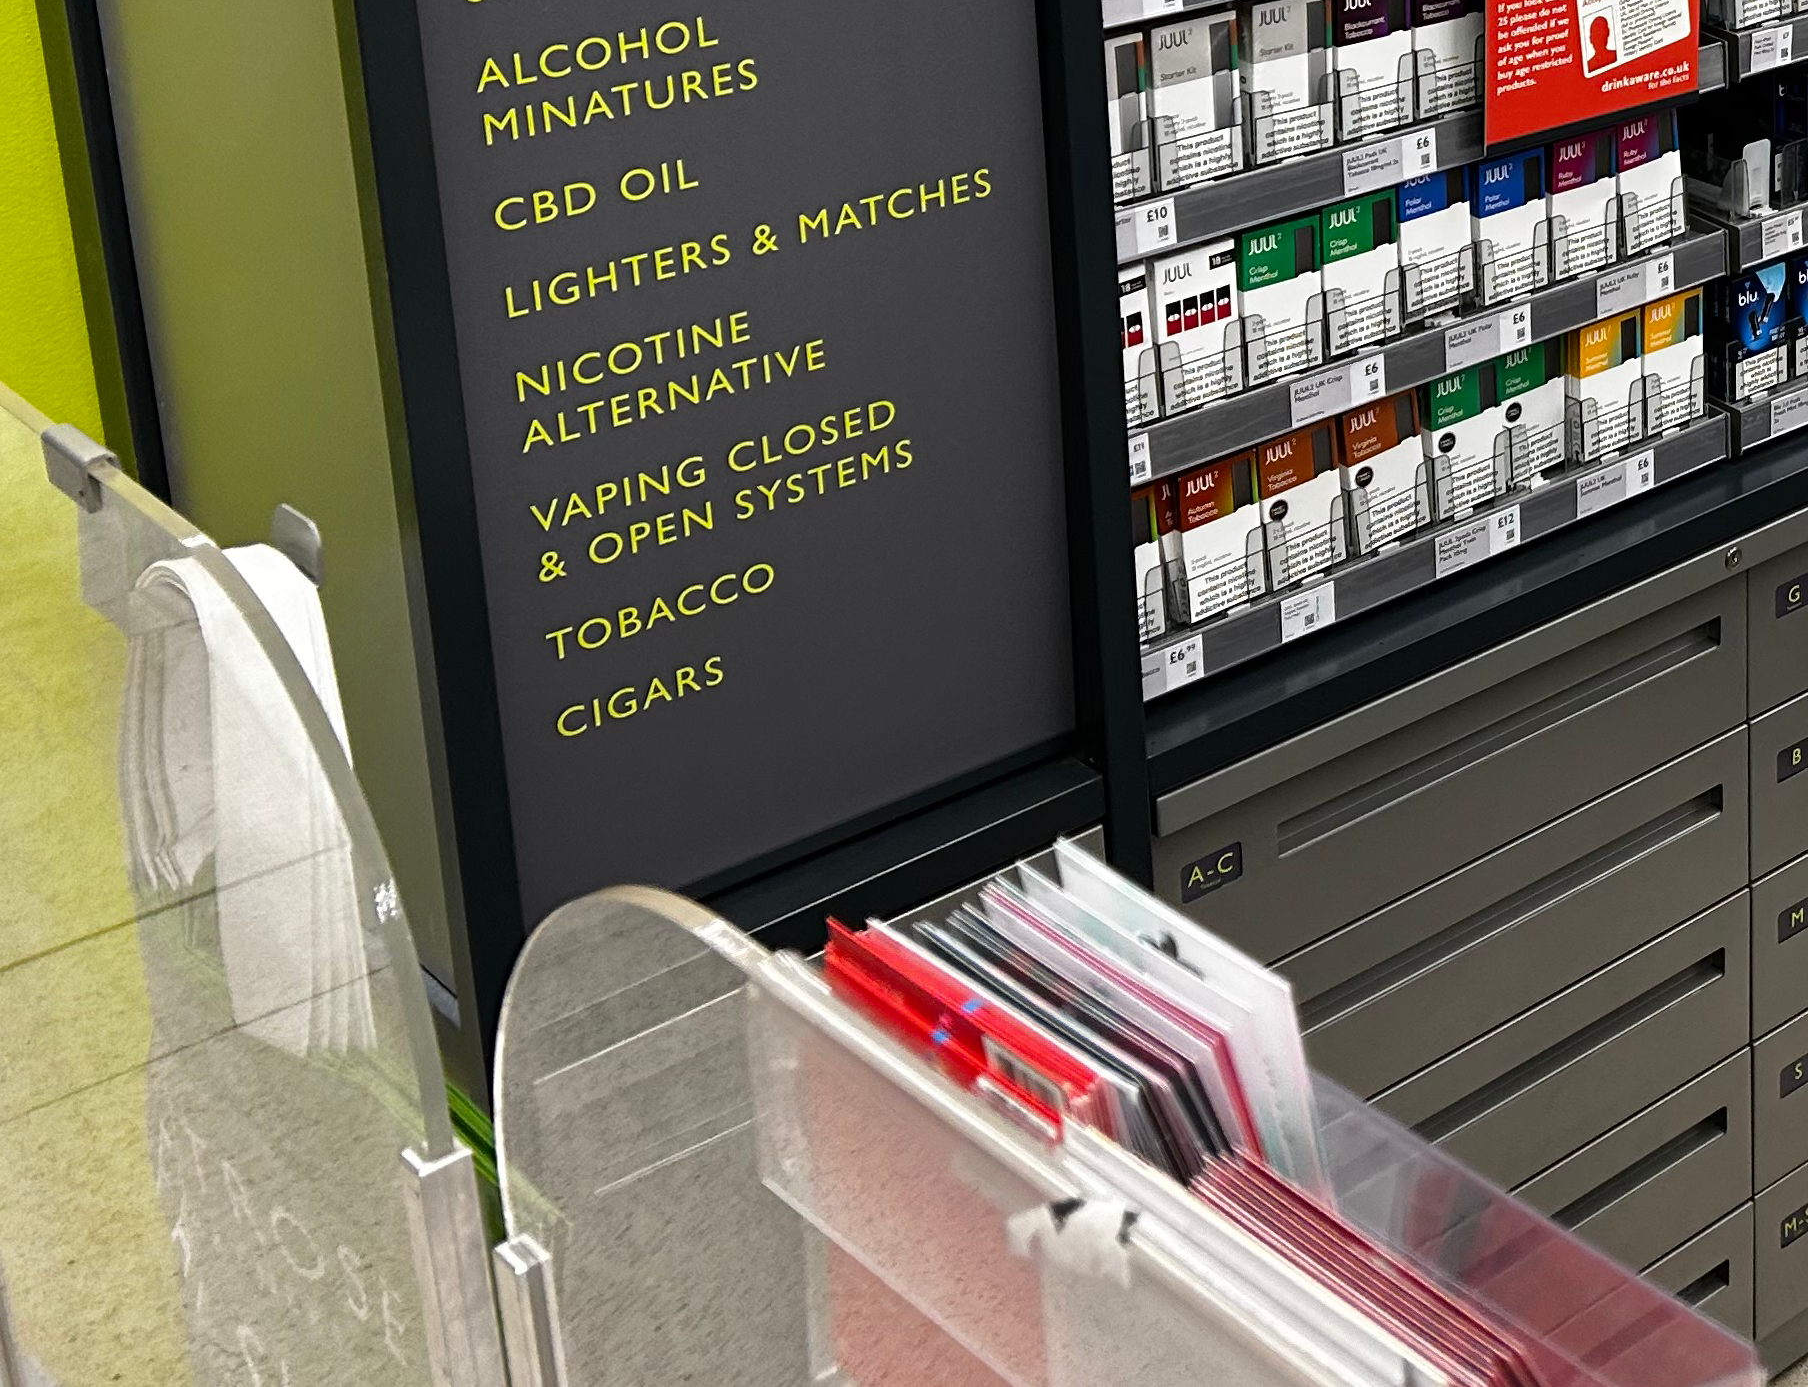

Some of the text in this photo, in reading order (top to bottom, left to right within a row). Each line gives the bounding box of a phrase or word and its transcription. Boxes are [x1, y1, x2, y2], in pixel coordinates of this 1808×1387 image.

[1497, 4, 1568, 27] 25 please do not
[1506, 1, 1523, 13] you
[1497, 29, 1508, 40] be
[1510, 21, 1548, 38] offended
[1556, 18, 1570, 27] we
[1497, 28, 1570, 54] ask you for proof
[477, 16, 719, 93] ALCOHOL
[1497, 43, 1566, 67] of age when you
[1496, 53, 1574, 81] buy age restricted
[1601, 61, 1690, 93] drinkaware.co.uk
[1496, 78, 1538, 96] products.
[1647, 73, 1690, 91] for the facts
[484, 59, 759, 146] MINATURES
[1558, 170, 1574, 182] Ruby
[494, 159, 700, 232] CBD OIL
[1146, 205, 1168, 224] £10
[505, 168, 993, 319] LIGHTERS & MATCHES
[1249, 264, 1269, 277] Crisp
[1249, 271, 1279, 284] Menthol
[1511, 311, 1526, 325] £6
[515, 311, 751, 403] NICOTINE
[522, 339, 826, 454] ALTERNATIVE
[530, 399, 897, 533] VAPING CLOSED
[538, 439, 914, 583] & OPEN SYSTEMS
[1188, 508, 1219, 524] Tobacco
[1497, 513, 1515, 529] £12
[1786, 583, 1801, 604] G
[545, 562, 776, 661] TOBACCO
[556, 655, 726, 739] CIGARS
[1791, 747, 1803, 767] B
[1186, 851, 1235, 887] A-C
[1788, 906, 1804, 927] M
[1793, 1061, 1804, 1080] S
